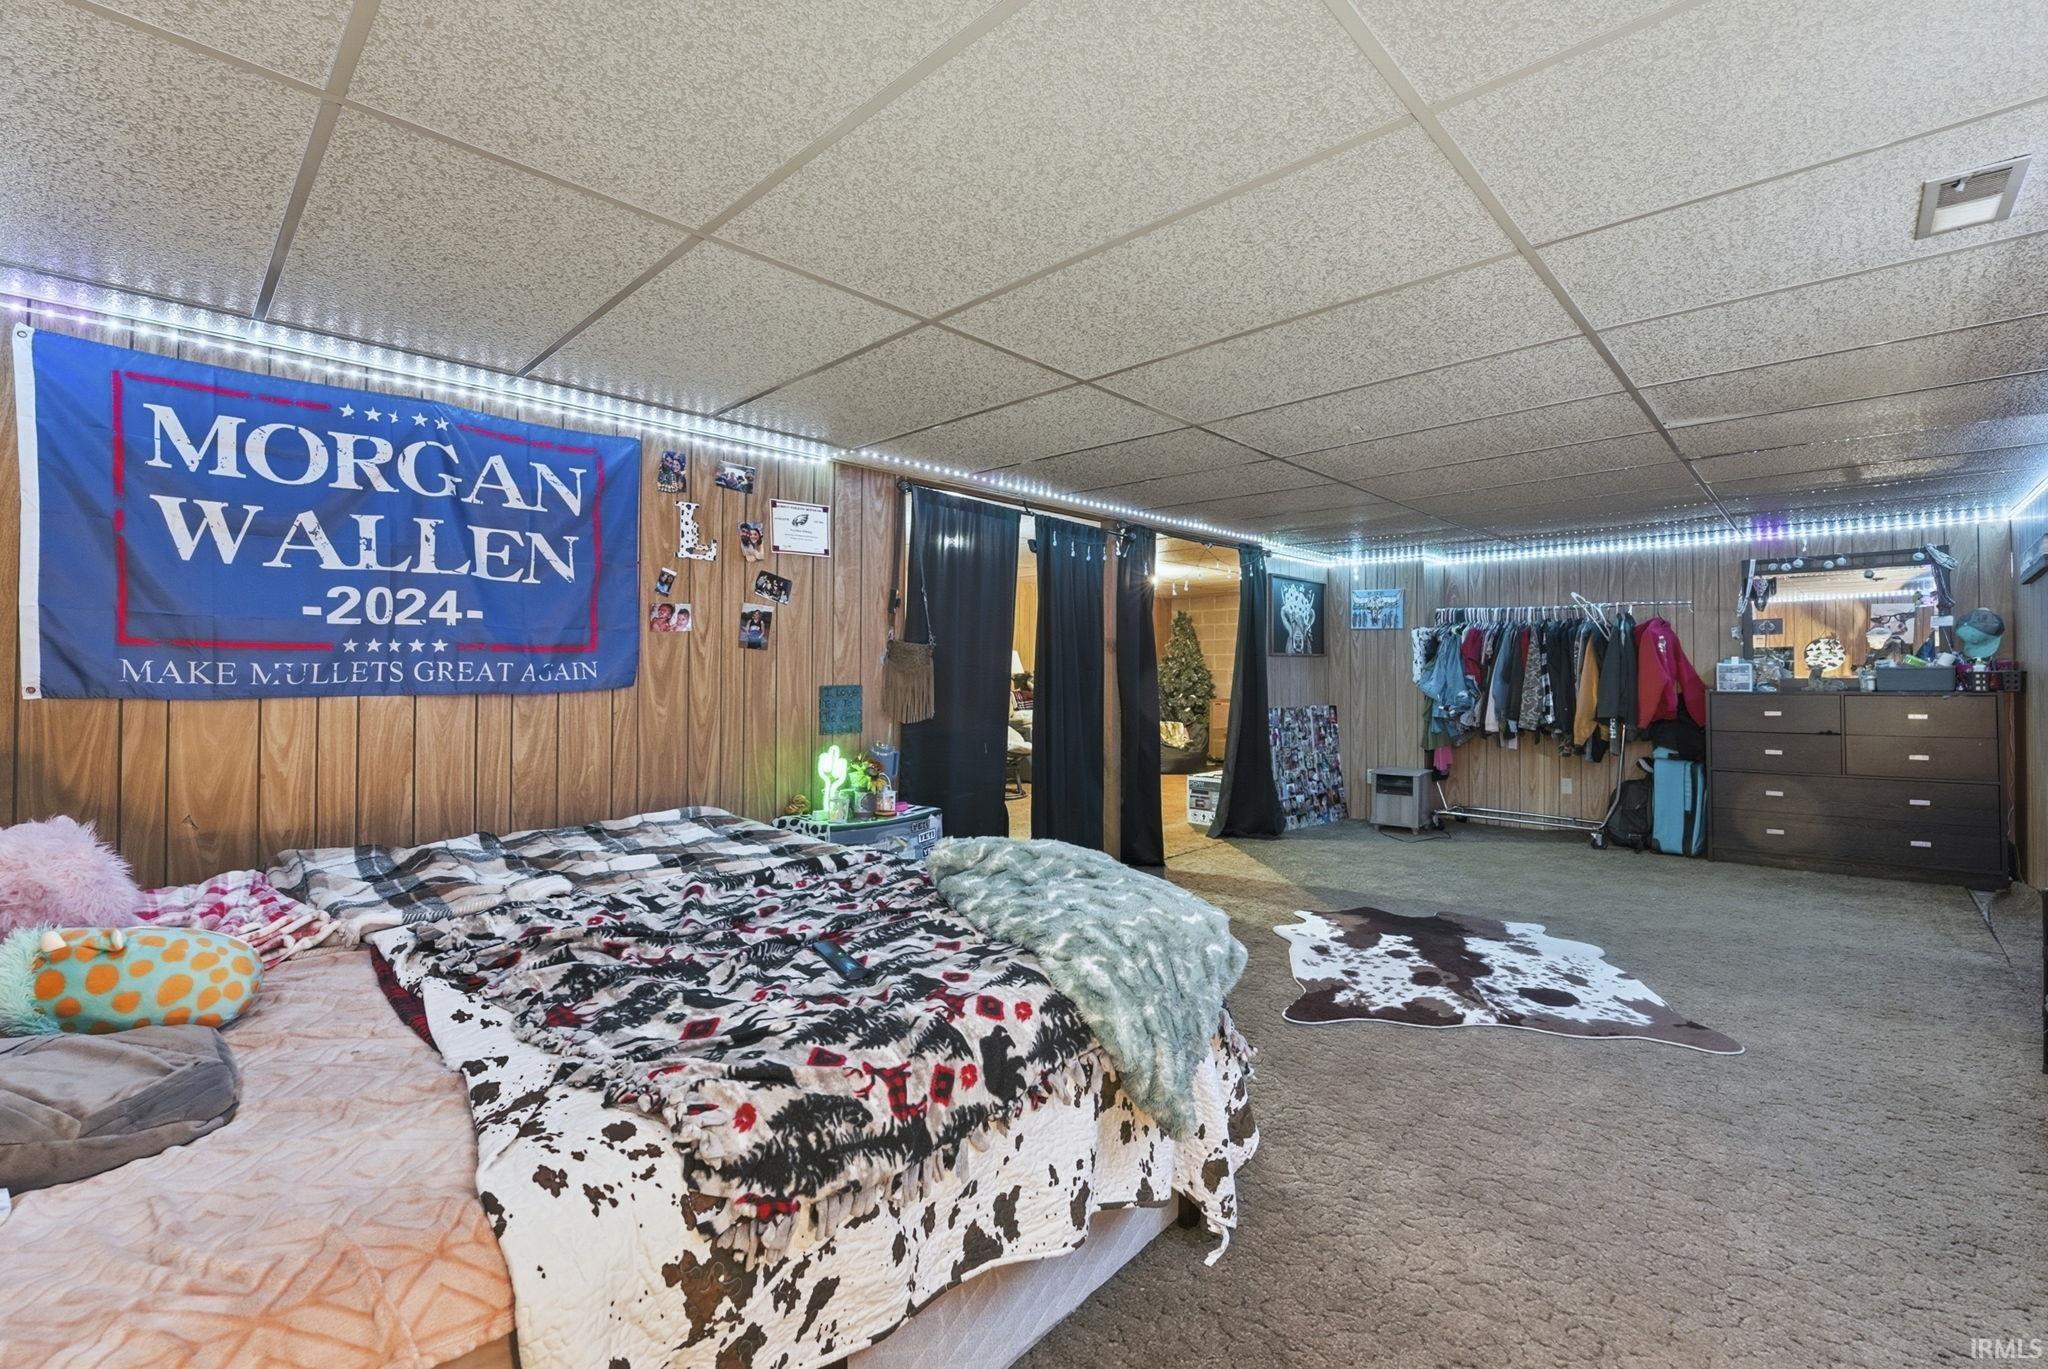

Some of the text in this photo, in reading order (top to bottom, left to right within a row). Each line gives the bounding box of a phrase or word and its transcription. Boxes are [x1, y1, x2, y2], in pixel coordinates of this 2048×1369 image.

[142, 403, 588, 517] MORGAN
[149, 494, 580, 584] WALLEN
[118, 658, 598, 686] MAKE MULLETS GREAT AGAIN
